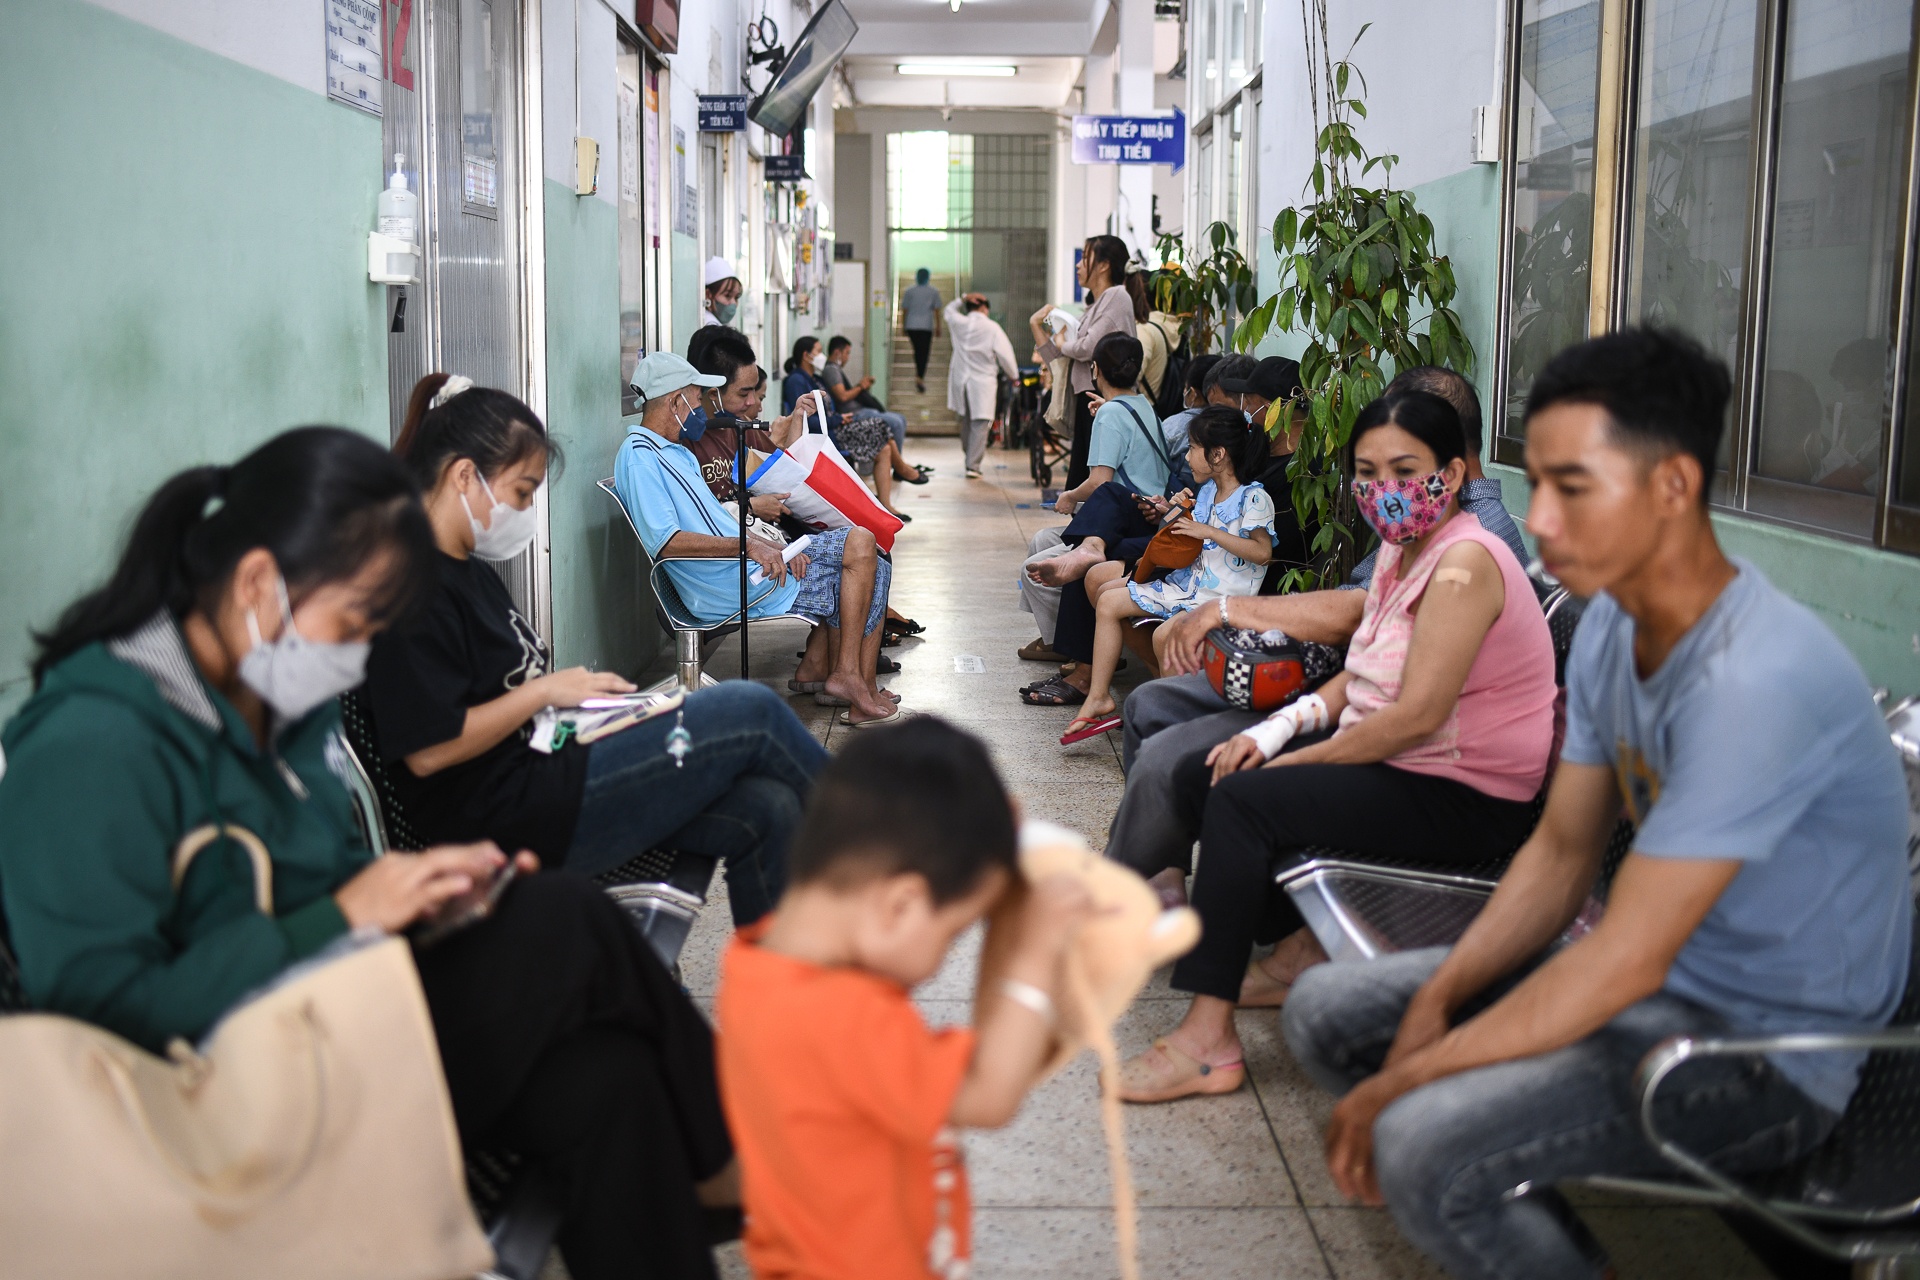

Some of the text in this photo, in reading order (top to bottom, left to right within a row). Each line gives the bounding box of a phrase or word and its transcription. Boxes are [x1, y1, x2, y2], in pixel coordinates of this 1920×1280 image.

[1111, 119, 1139, 139] TIẾP
[1140, 121, 1174, 142] NHẬN
[1098, 144, 1121, 160] THU
